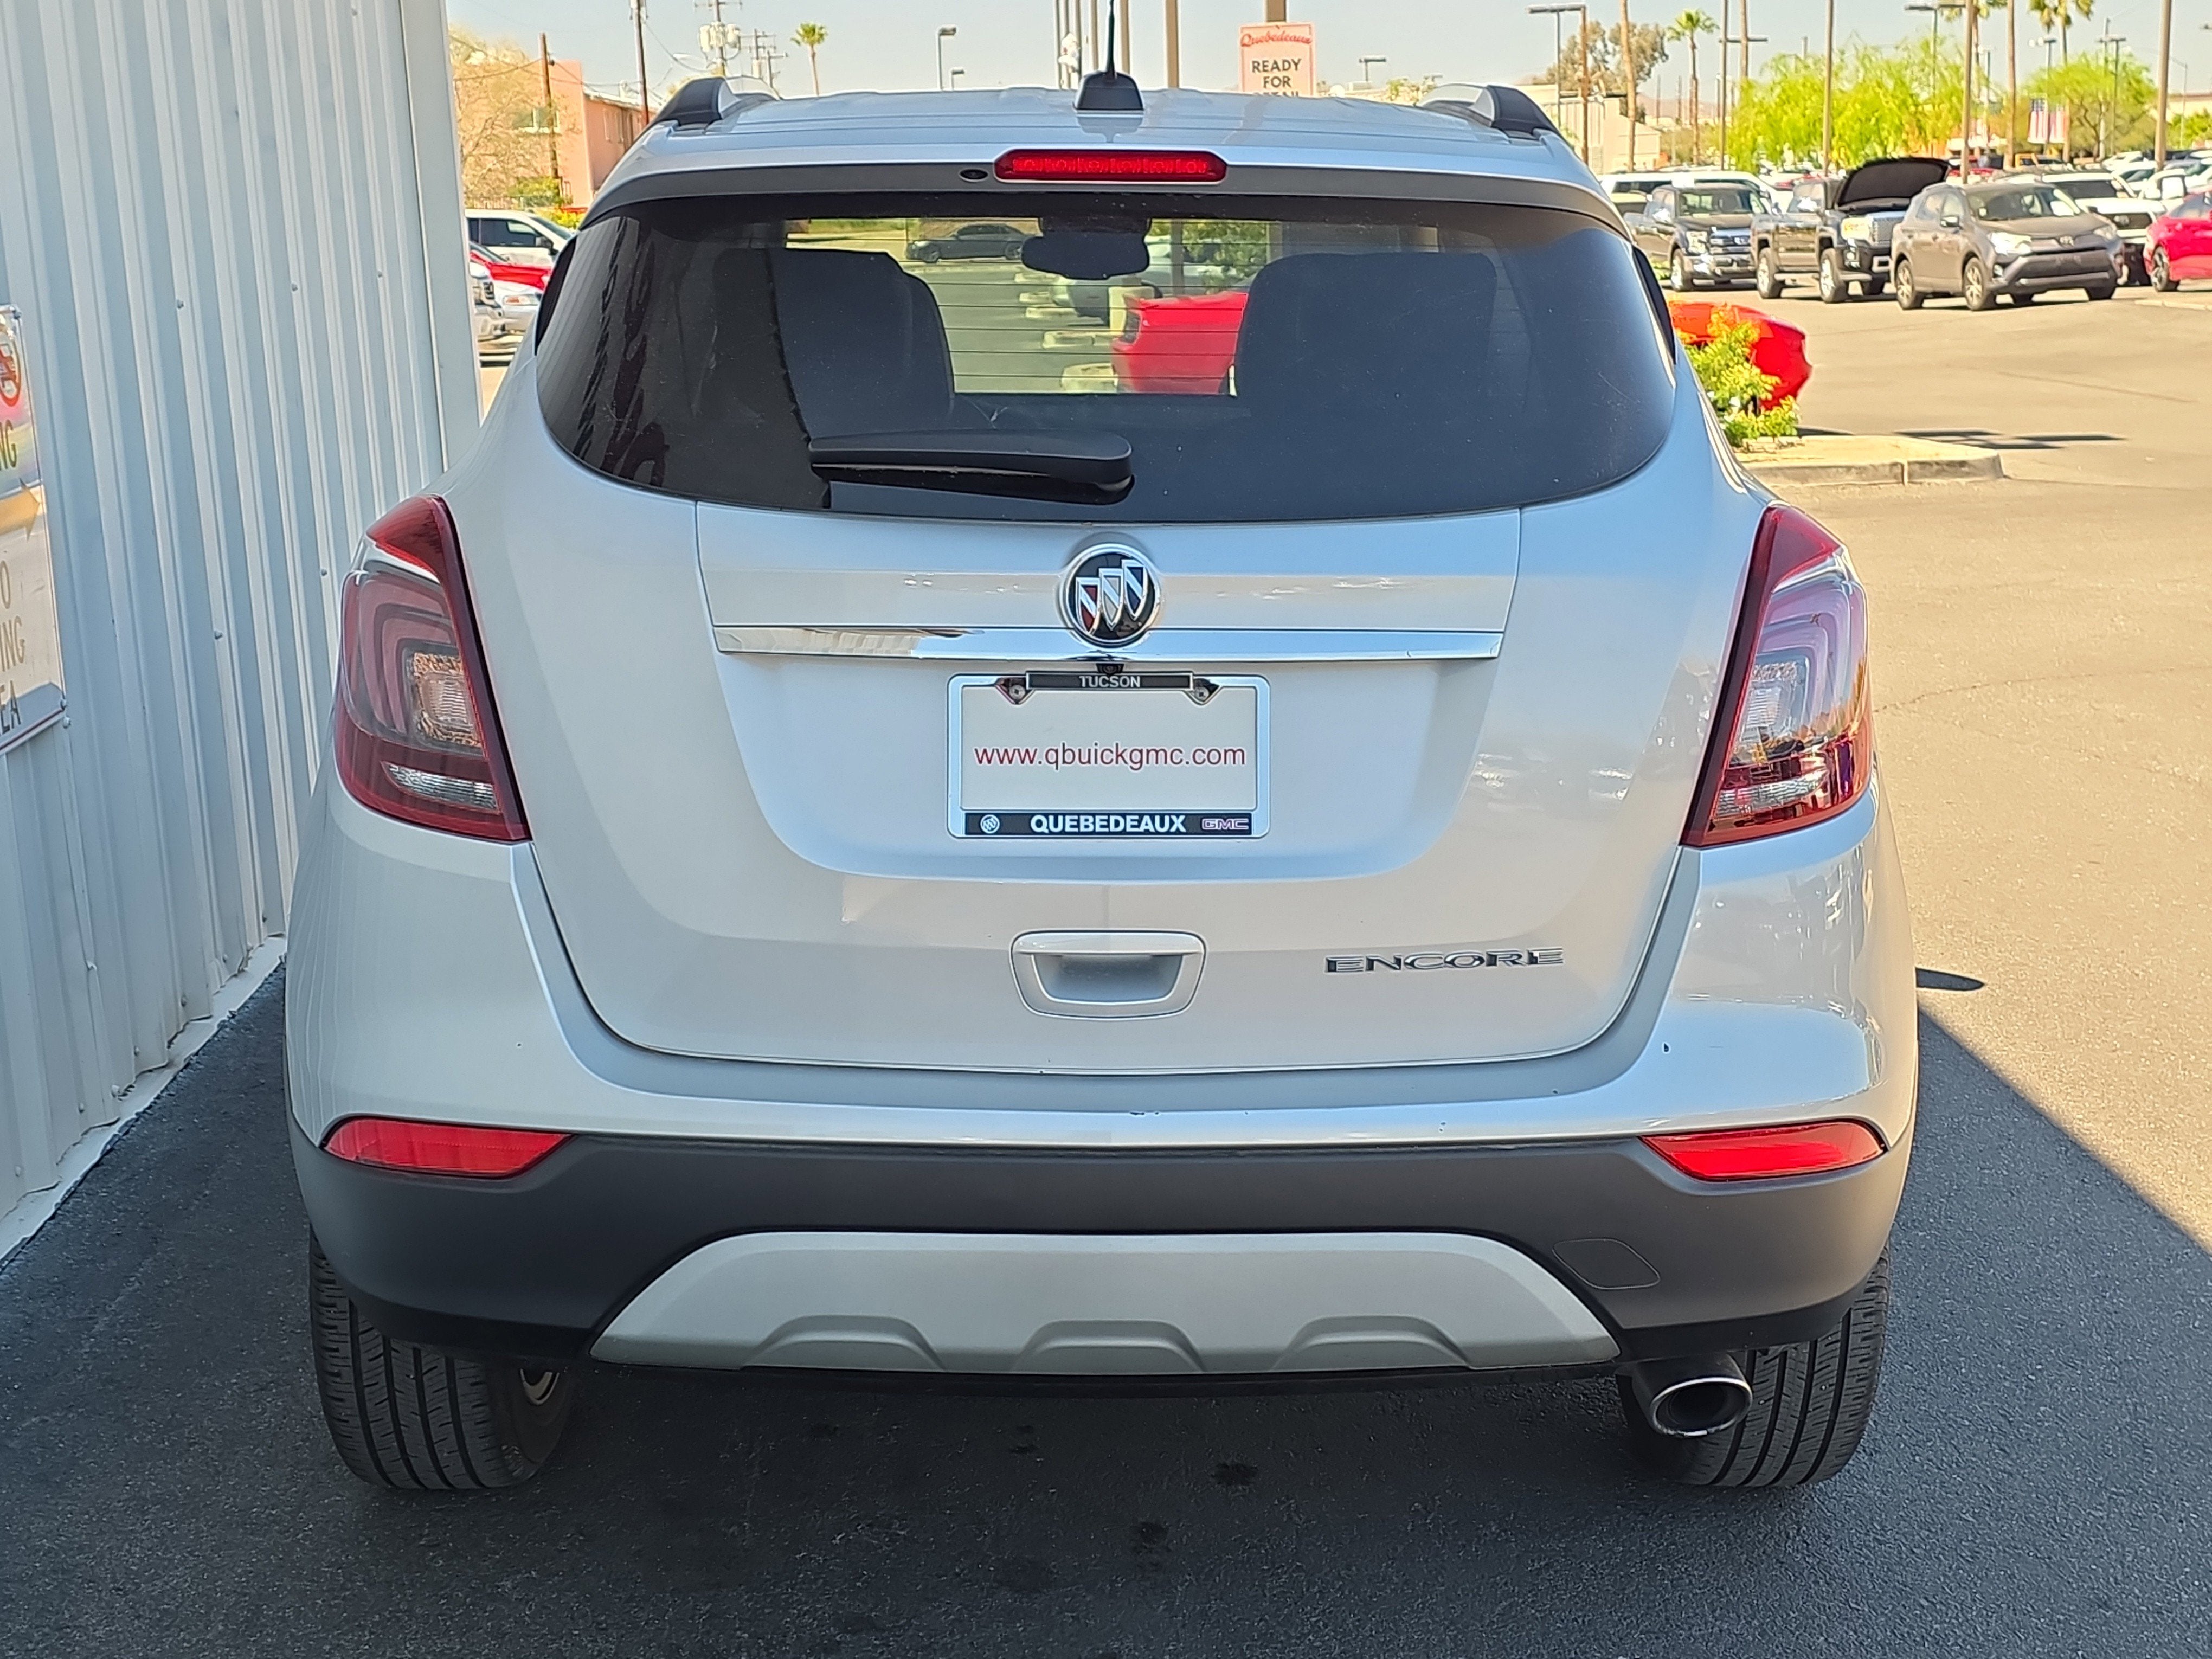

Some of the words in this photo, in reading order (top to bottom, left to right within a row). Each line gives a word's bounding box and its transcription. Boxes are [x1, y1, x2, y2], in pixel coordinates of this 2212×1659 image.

[1252, 58, 1302, 73] READY
[1263, 75, 1291, 88] FOR
[1079, 676, 1141, 688] TUCSON
[975, 742, 1245, 770] www.qbuickgmc.com
[1031, 815, 1186, 833] QUEBEDEAUX
[1201, 818, 1249, 829] GMC
[1324, 947, 1564, 973] ENCORE
